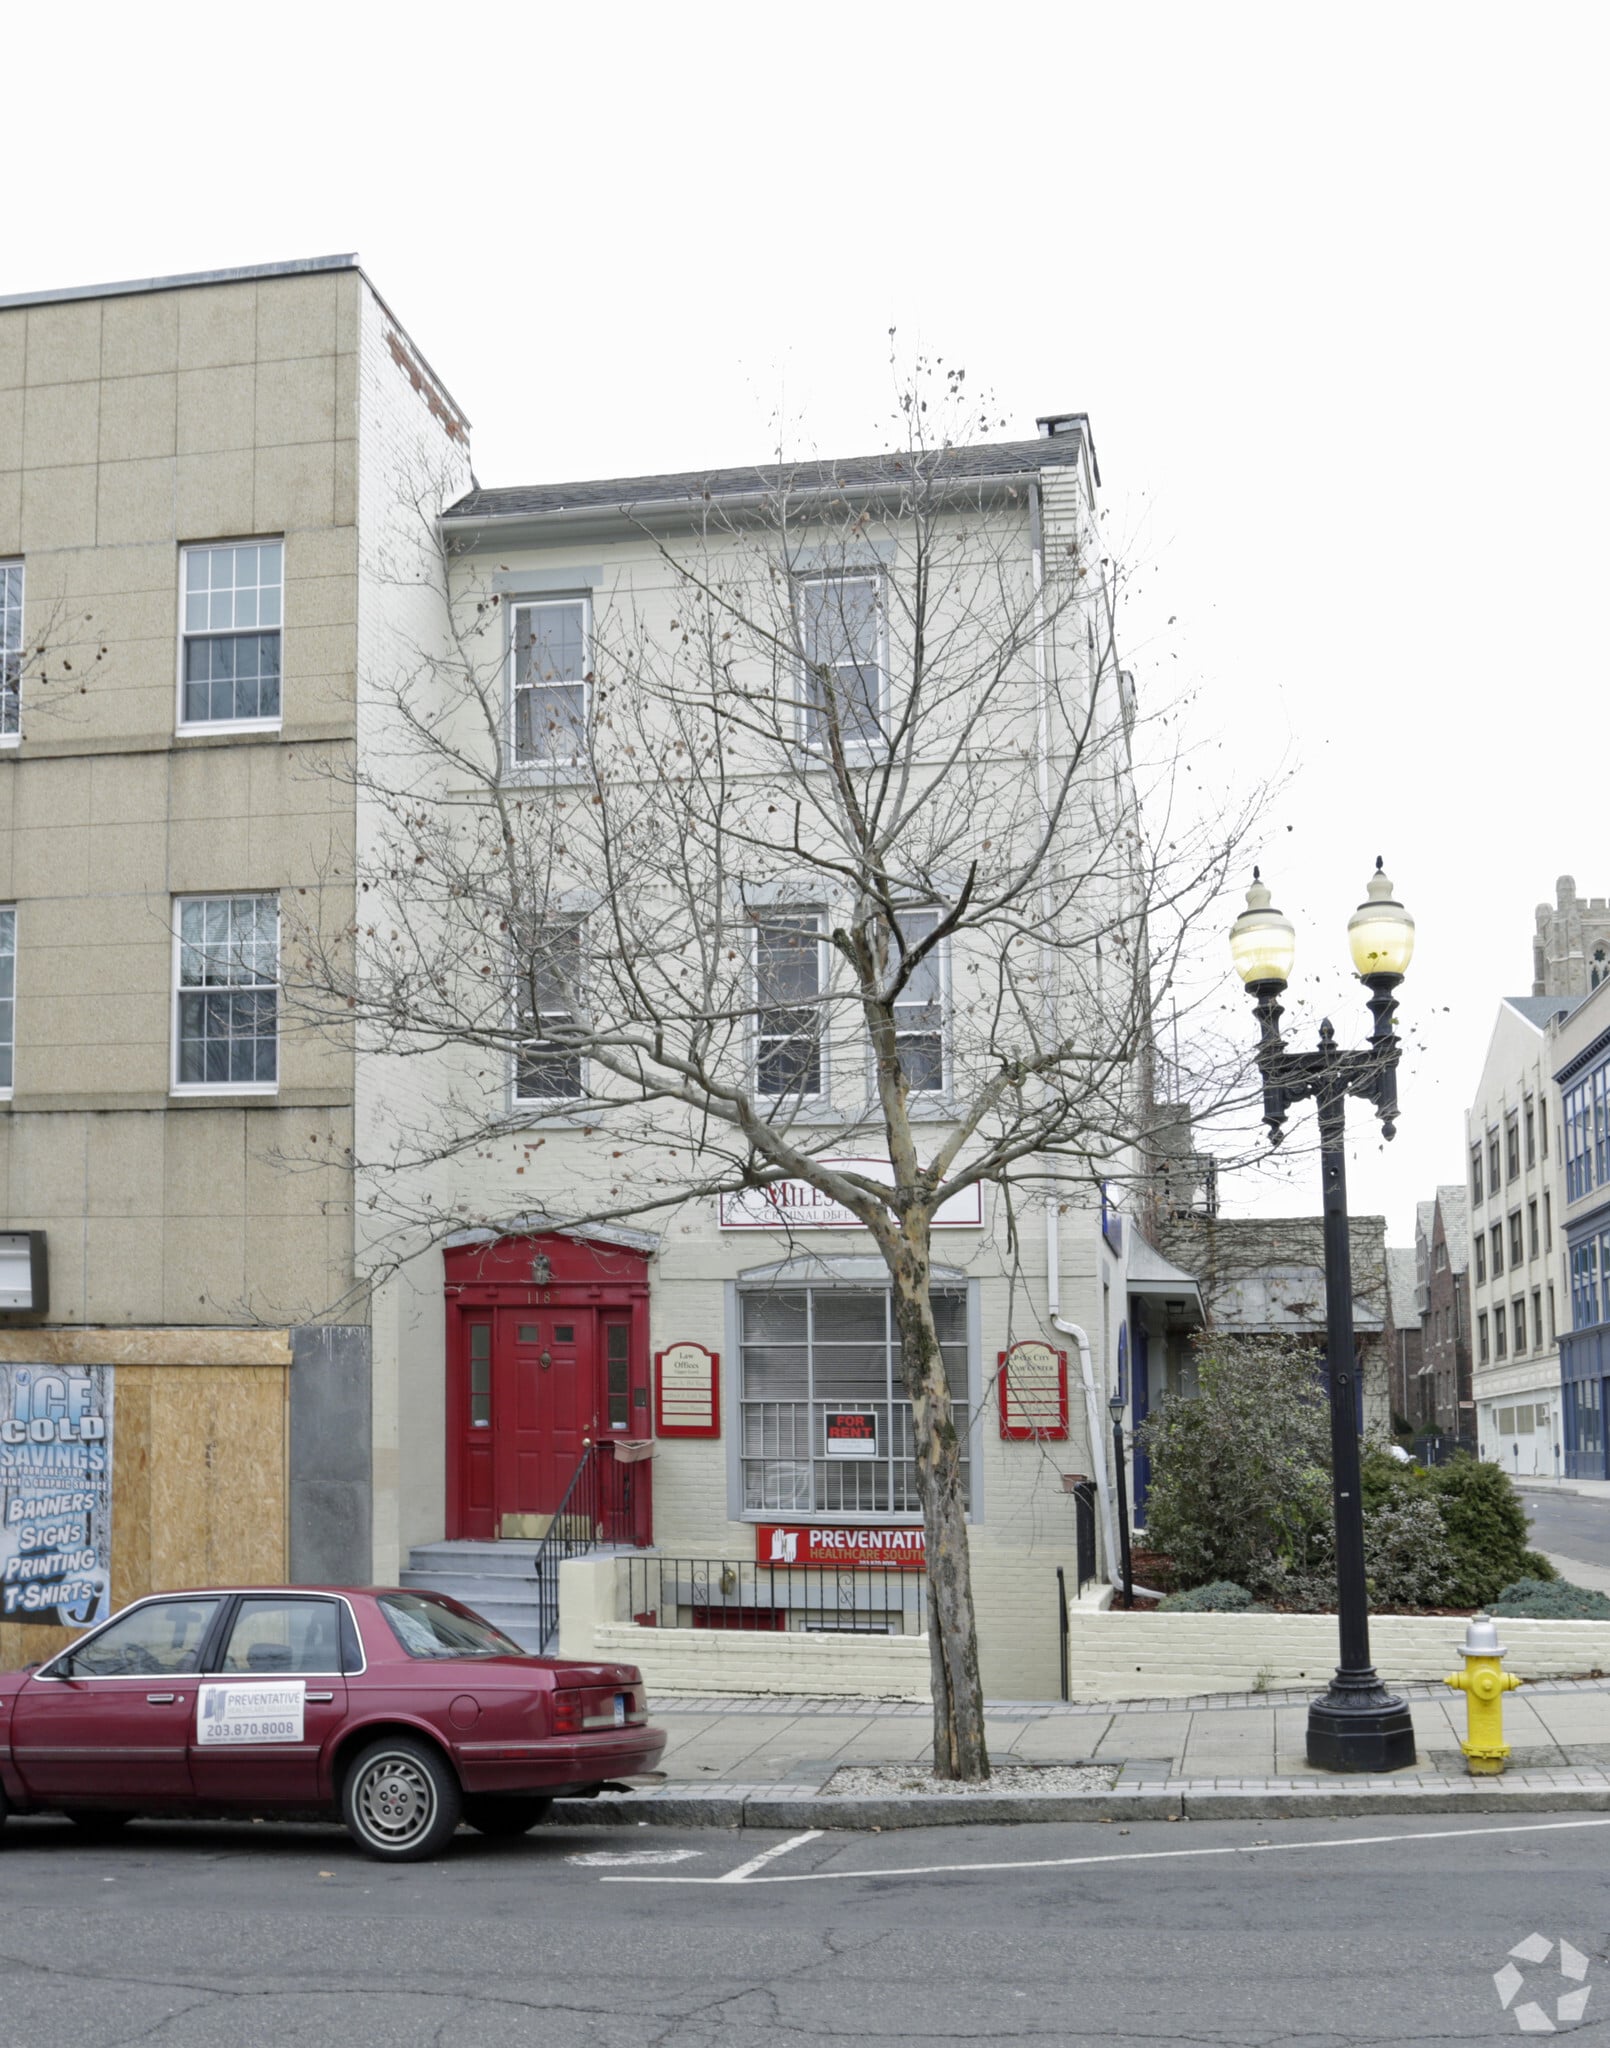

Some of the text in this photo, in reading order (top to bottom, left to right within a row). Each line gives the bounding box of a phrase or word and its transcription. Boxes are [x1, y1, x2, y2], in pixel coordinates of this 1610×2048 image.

[1, 1416, 105, 1443] COLD
[836, 1415, 865, 1427] FOR
[829, 1427, 873, 1438] RENT
[0, 1444, 105, 1471] SAVINGS
[0, 1478, 21, 1487] RINT
[9, 1493, 95, 1522] BANNERS
[20, 1524, 81, 1550] SIGNS
[809, 1530, 926, 1549] PREVENTATI
[810, 1548, 926, 1561] HEALTHCARE SOLUTI
[6, 1549, 96, 1580] PRINTING
[6, 1582, 92, 1610] T-SHIRTS
[227, 1692, 301, 1706] PREVENTATIVE
[207, 1722, 294, 1737] 203.870.8008
